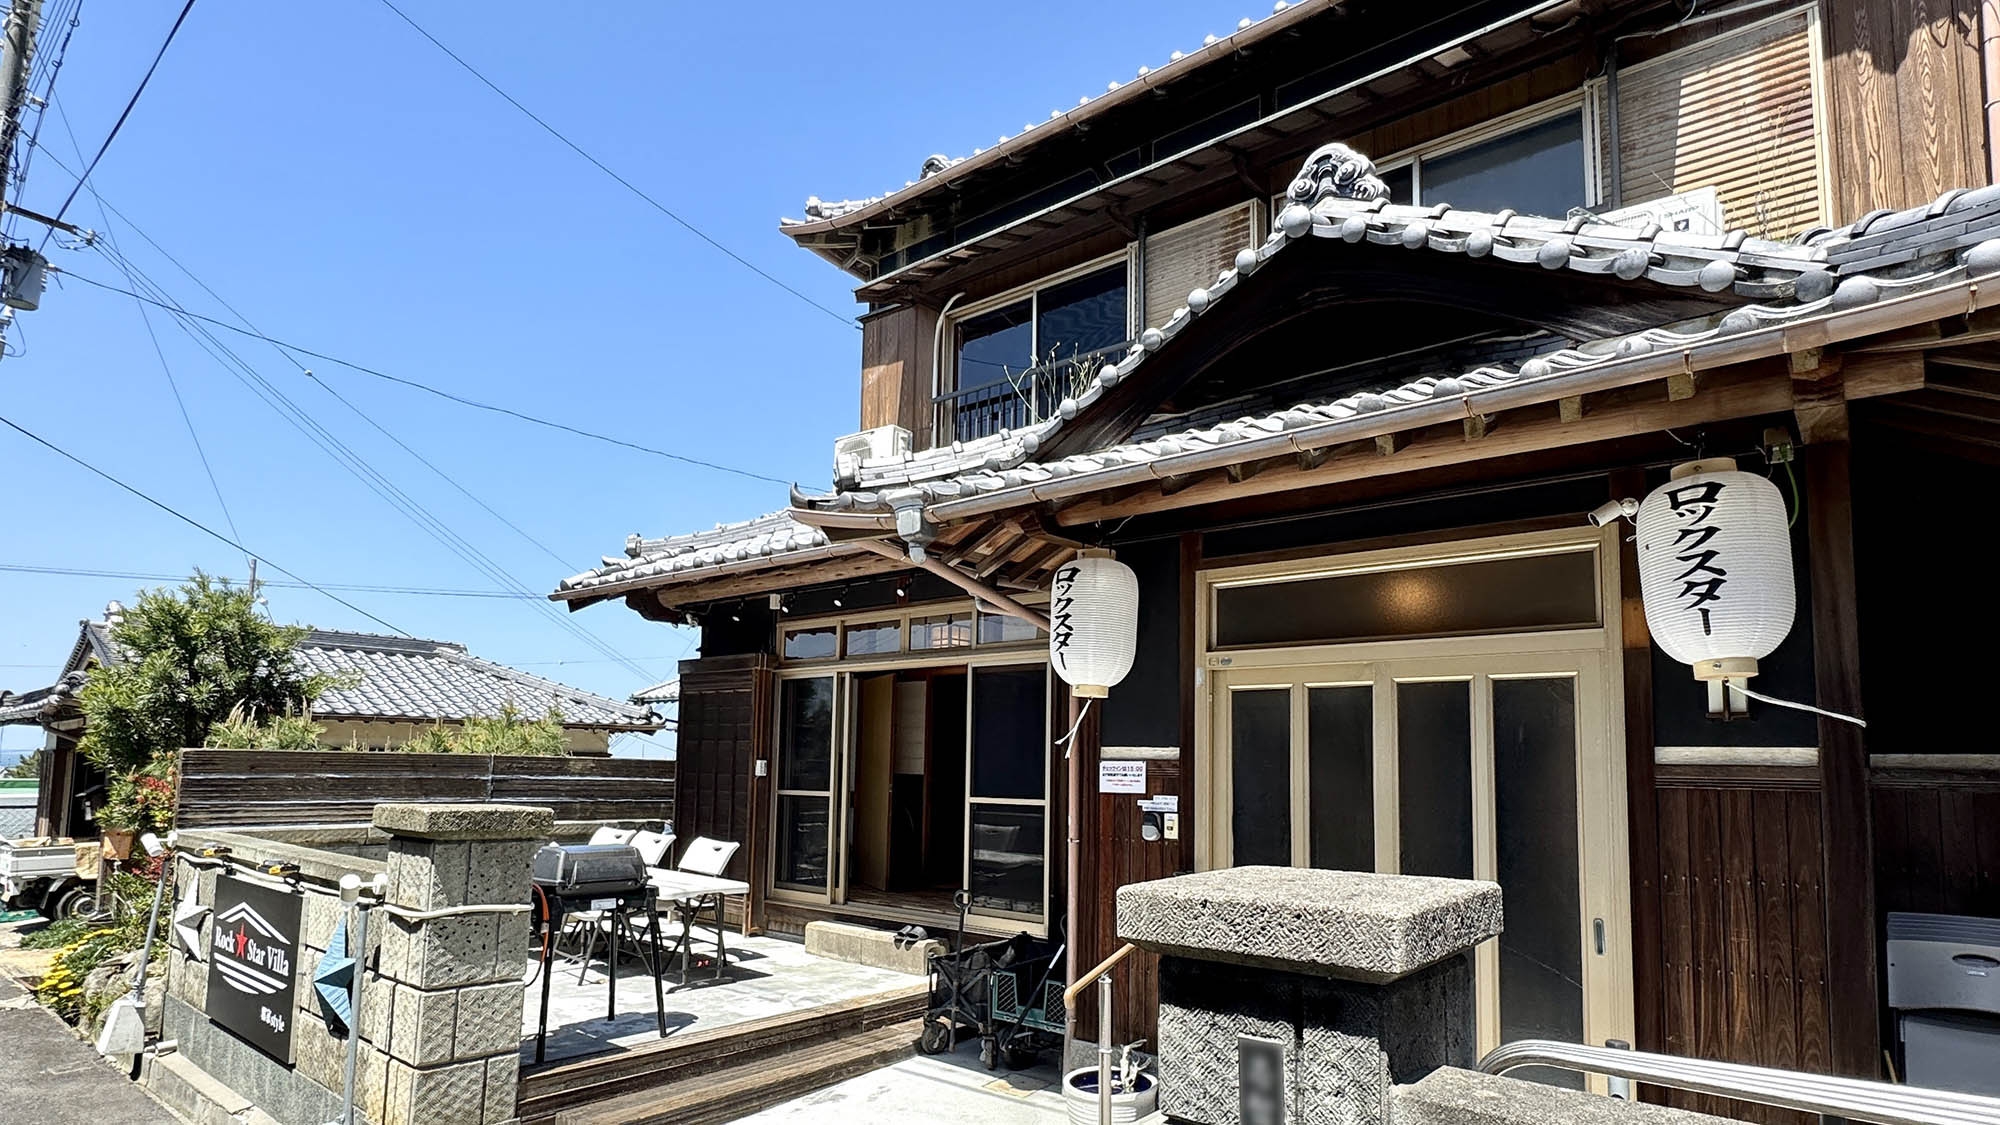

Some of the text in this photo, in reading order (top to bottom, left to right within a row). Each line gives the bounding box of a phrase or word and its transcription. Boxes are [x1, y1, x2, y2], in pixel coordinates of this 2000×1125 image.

[1664, 481, 1727, 636] ロックスター
[1053, 567, 1081, 670] ロックスター
[214, 925, 290, 977] Rock Star Villa
